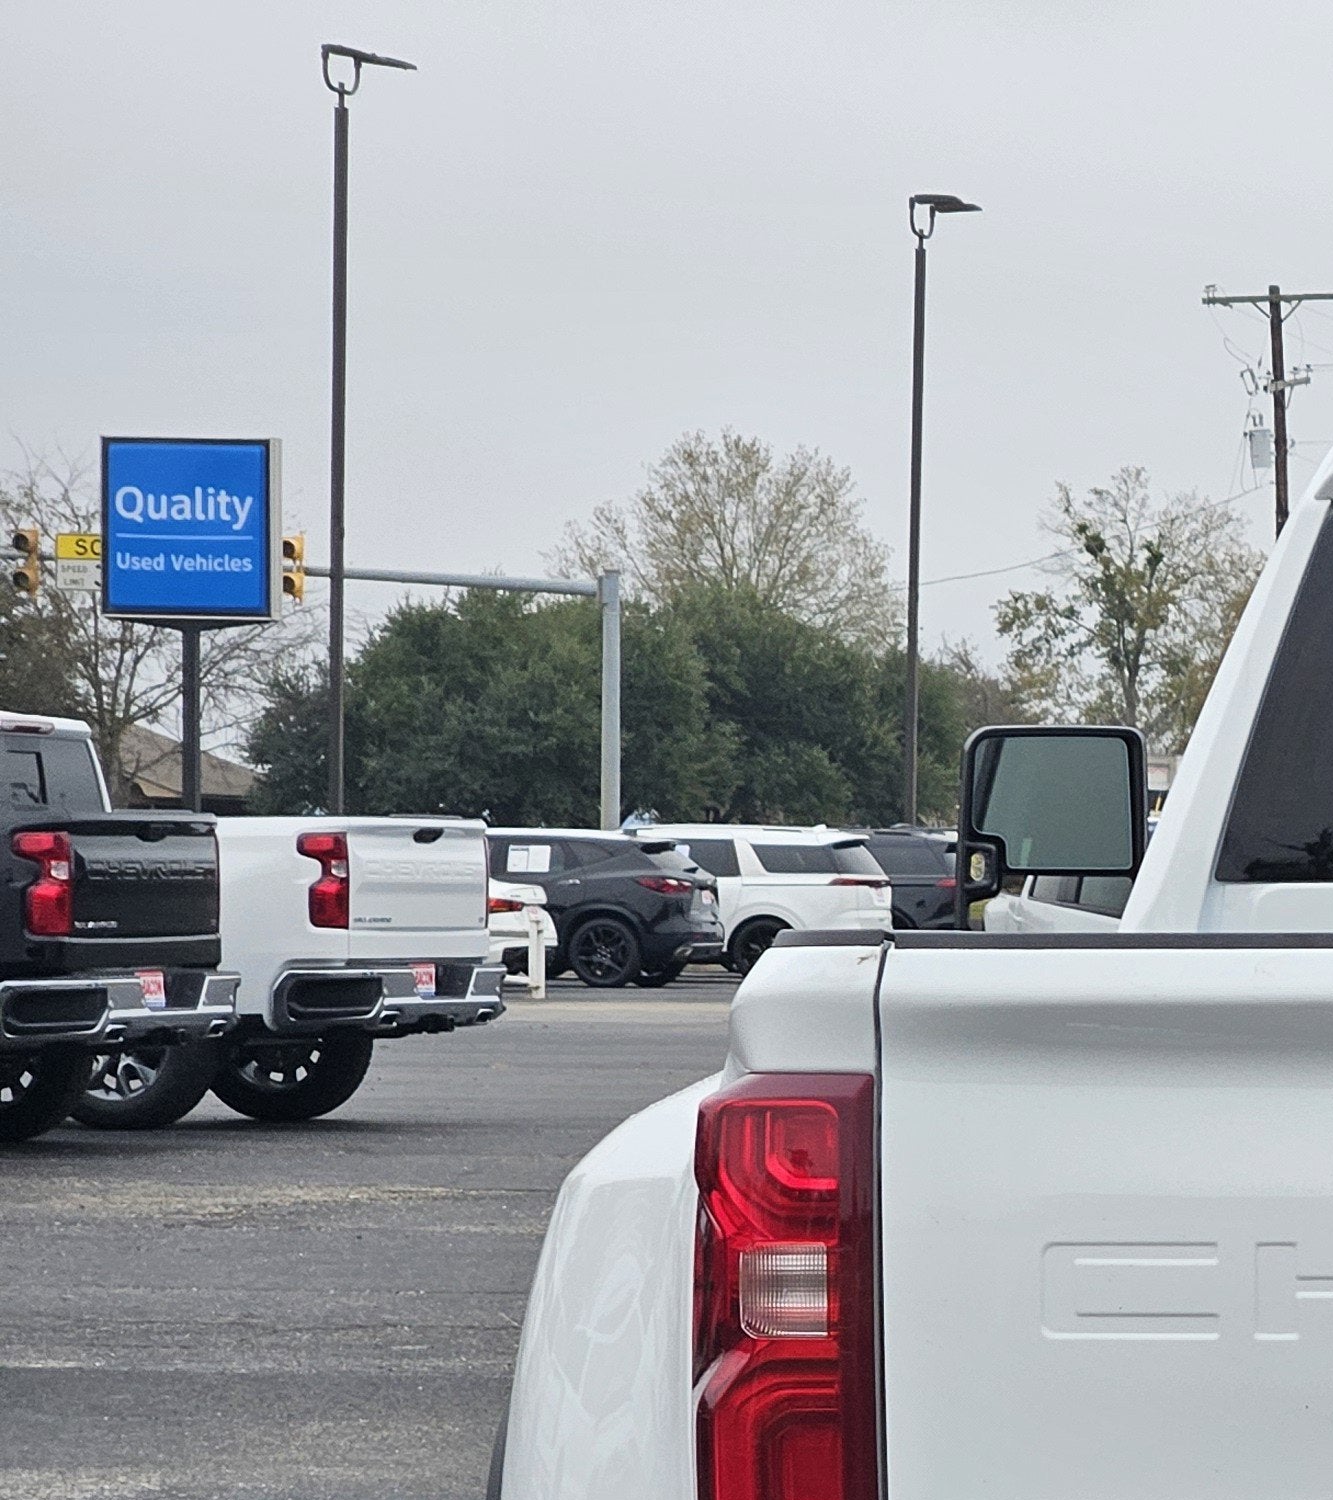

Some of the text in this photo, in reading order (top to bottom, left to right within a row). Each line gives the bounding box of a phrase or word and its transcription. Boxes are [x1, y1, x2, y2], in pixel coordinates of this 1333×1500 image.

[115, 486, 253, 530] Quality
[116, 552, 253, 572] Used Vehicles
